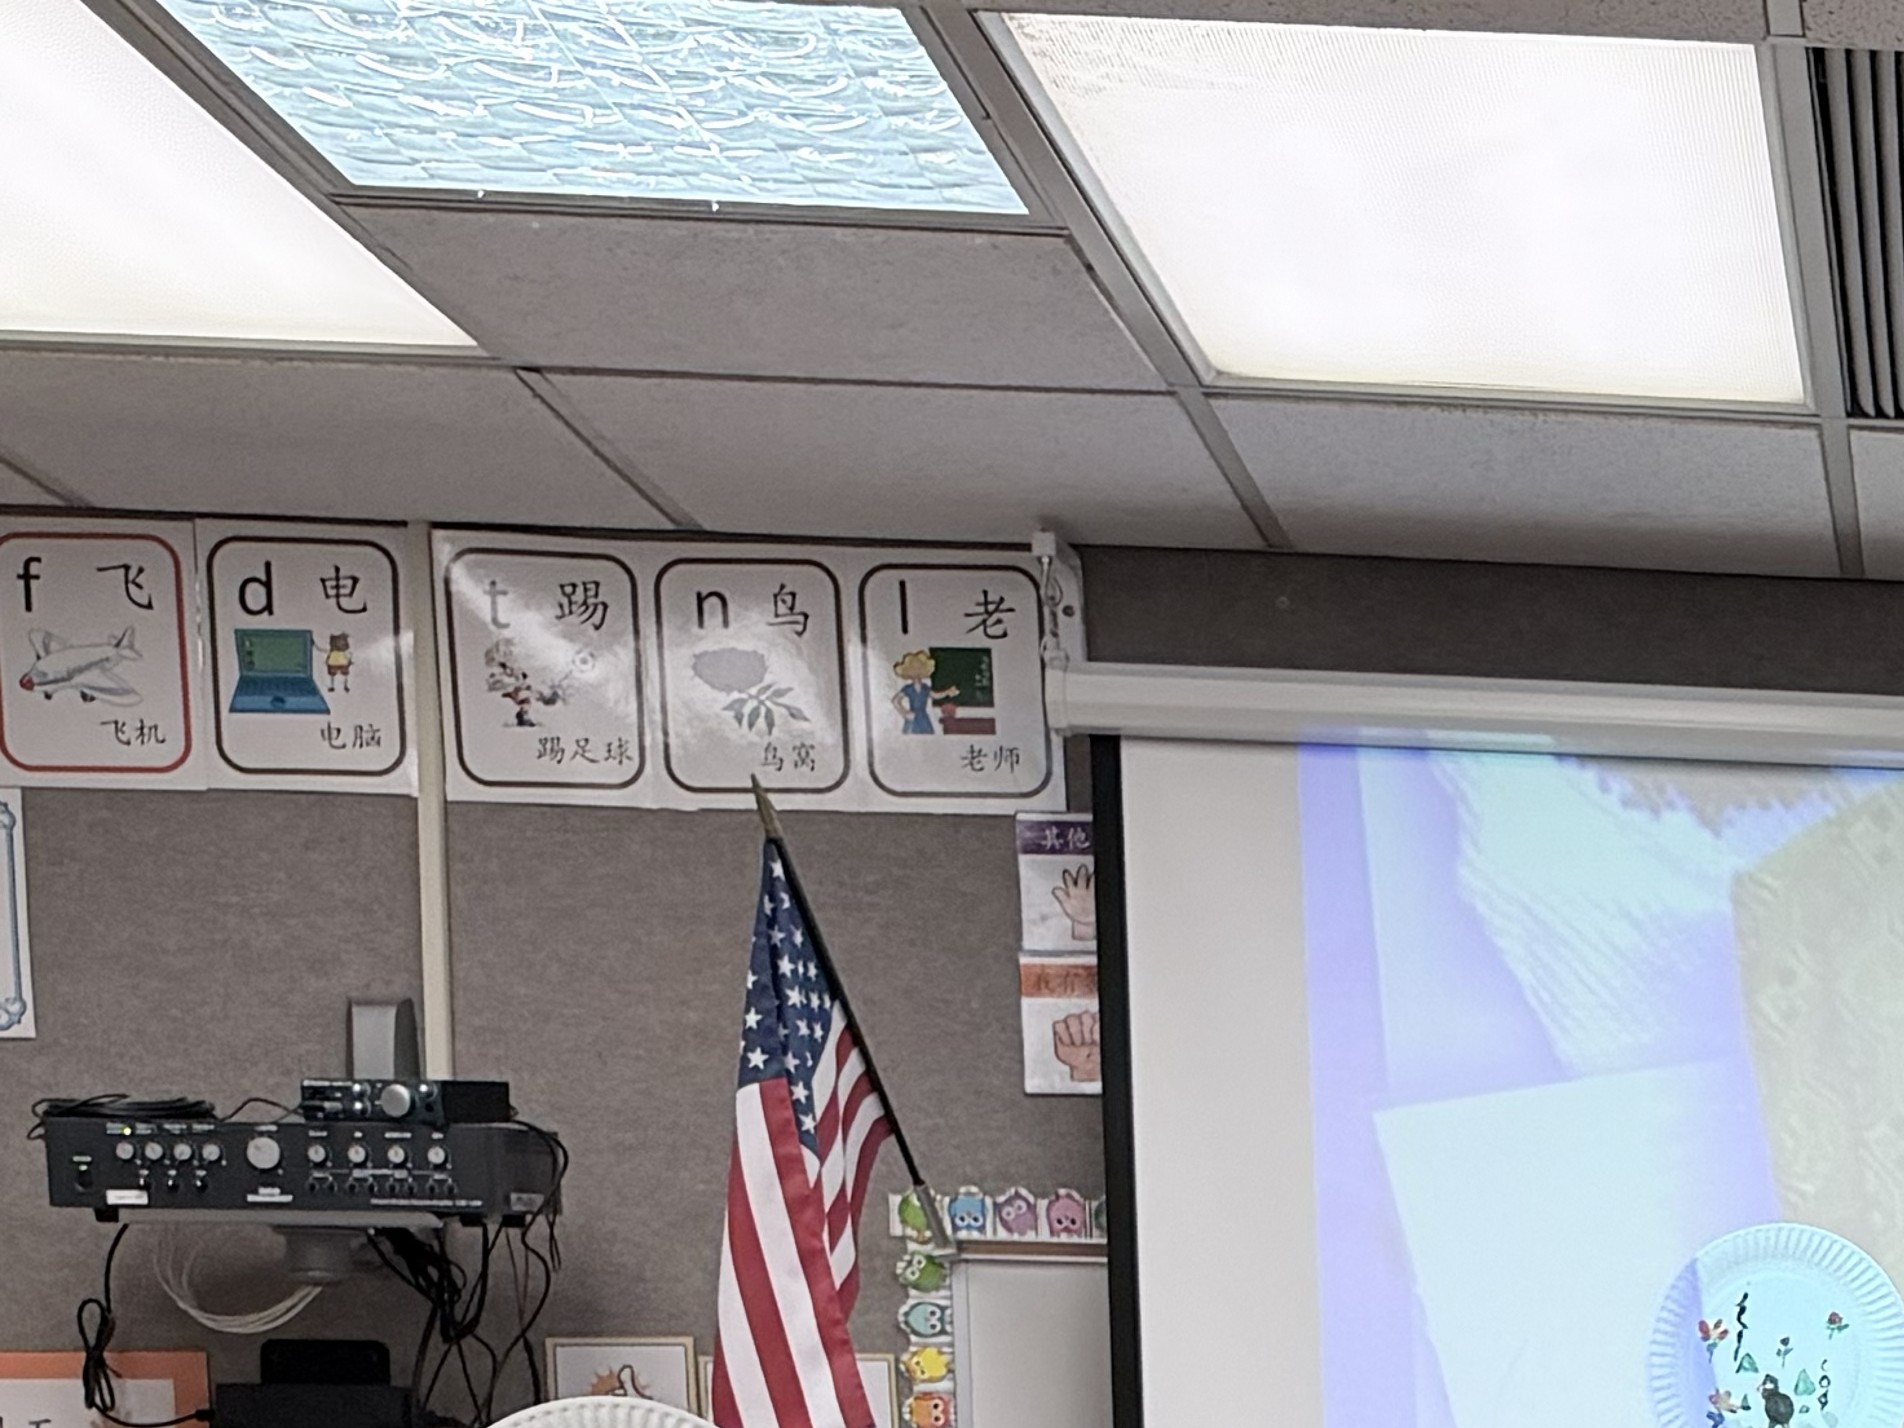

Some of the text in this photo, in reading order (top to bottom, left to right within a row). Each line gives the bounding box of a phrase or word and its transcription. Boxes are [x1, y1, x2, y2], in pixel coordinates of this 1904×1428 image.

[16, 557, 153, 612] f 飞
[239, 561, 368, 616] d 电
[483, 580, 609, 634] t 踢
[697, 583, 810, 638] n 鸟
[963, 589, 1016, 640] 老
[100, 718, 166, 747] 飞机
[319, 722, 382, 751] 电脑
[536, 736, 634, 765] 踢足球
[761, 742, 817, 772] 鸟窝
[959, 744, 1021, 773] 老师
